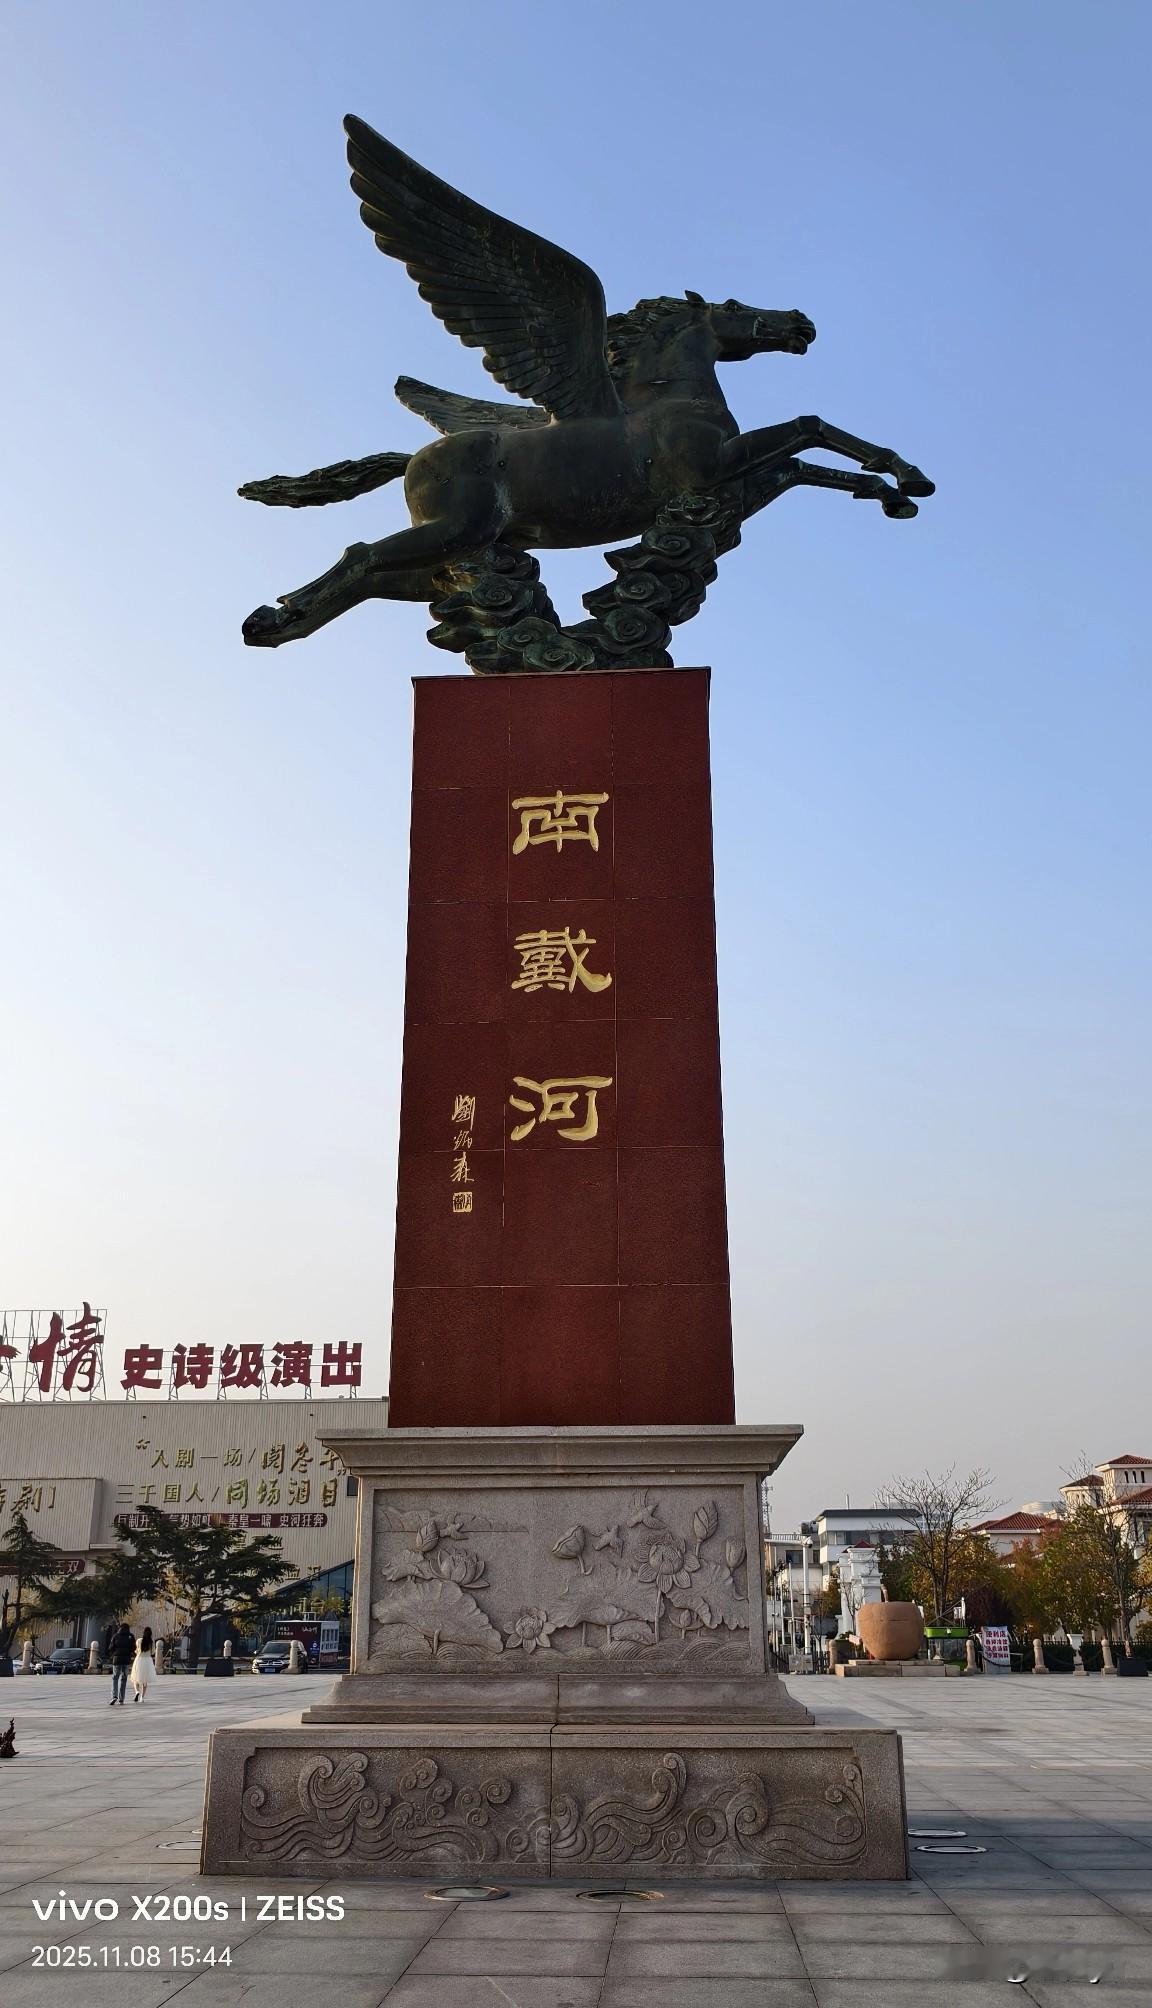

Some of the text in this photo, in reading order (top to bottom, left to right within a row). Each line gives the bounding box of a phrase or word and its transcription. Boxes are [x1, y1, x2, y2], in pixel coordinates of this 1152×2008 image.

[510, 789, 613, 1141] 南戴河
[0, 1301, 363, 1393] 情 史诗级演出
[279, 1513, 325, 1528] 史河狂奔
